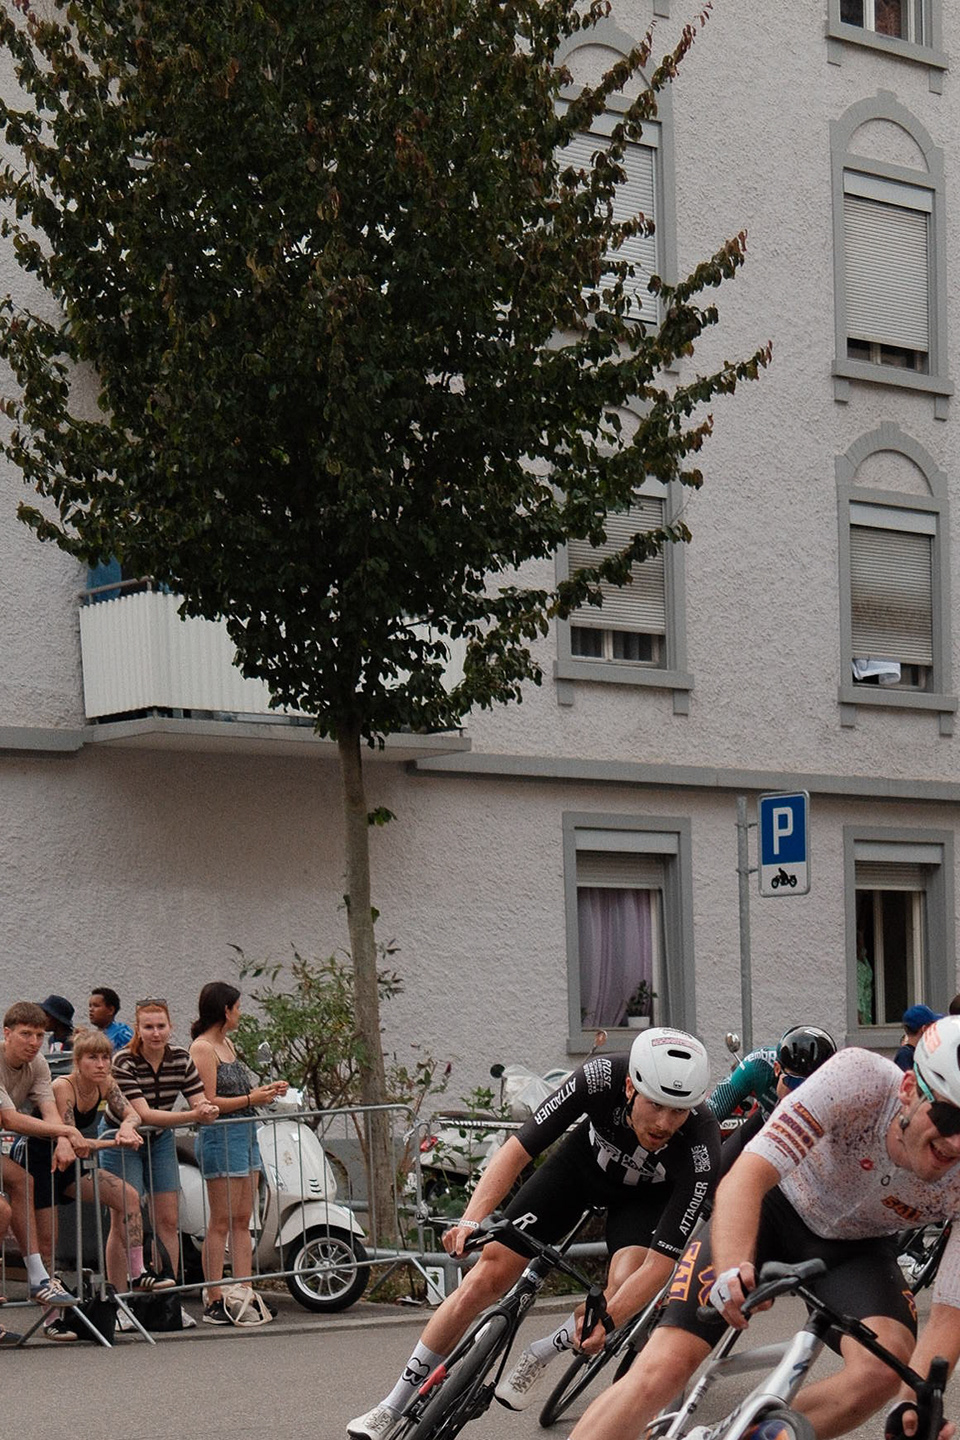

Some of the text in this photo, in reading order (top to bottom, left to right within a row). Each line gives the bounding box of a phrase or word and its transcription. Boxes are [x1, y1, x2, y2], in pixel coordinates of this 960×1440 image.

[773, 806, 793, 855] P
[534, 1077, 577, 1125] ATTAQUER
[512, 1212, 538, 1231] R
[679, 1181, 709, 1236] ATTAQUER
